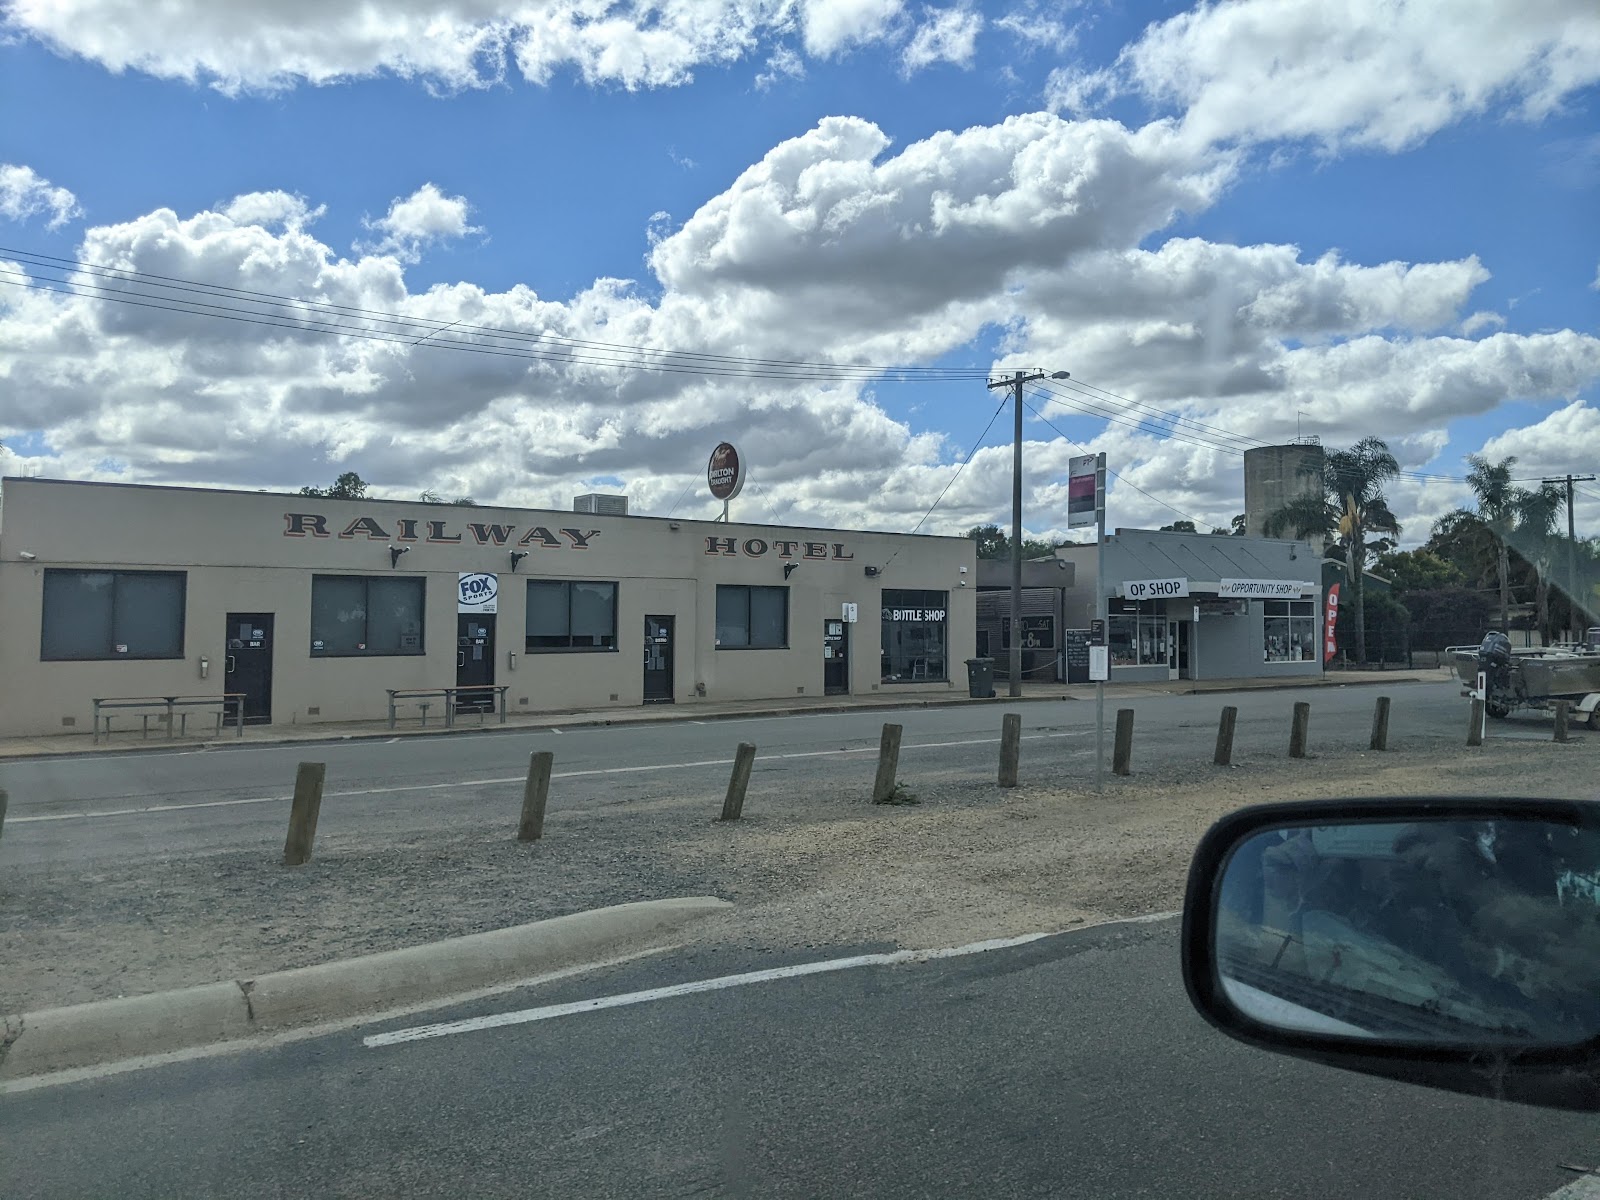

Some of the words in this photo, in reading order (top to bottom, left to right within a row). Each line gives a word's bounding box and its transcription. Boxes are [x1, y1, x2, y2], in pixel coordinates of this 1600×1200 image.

[283, 513, 601, 550] RAILWAY
[705, 536, 854, 562] HOTEL
[460, 577, 492, 597] FOX
[462, 590, 493, 602] SPORTS
[1130, 583, 1146, 597] OP
[1149, 581, 1181, 596] SHOP
[1231, 582, 1275, 594] OPPORTUNITY
[1276, 584, 1292, 594] SHOP
[893, 609, 923, 621] BOTTLE
[925, 609, 946, 622] SHOP
[1327, 593, 1338, 653] OPEN
